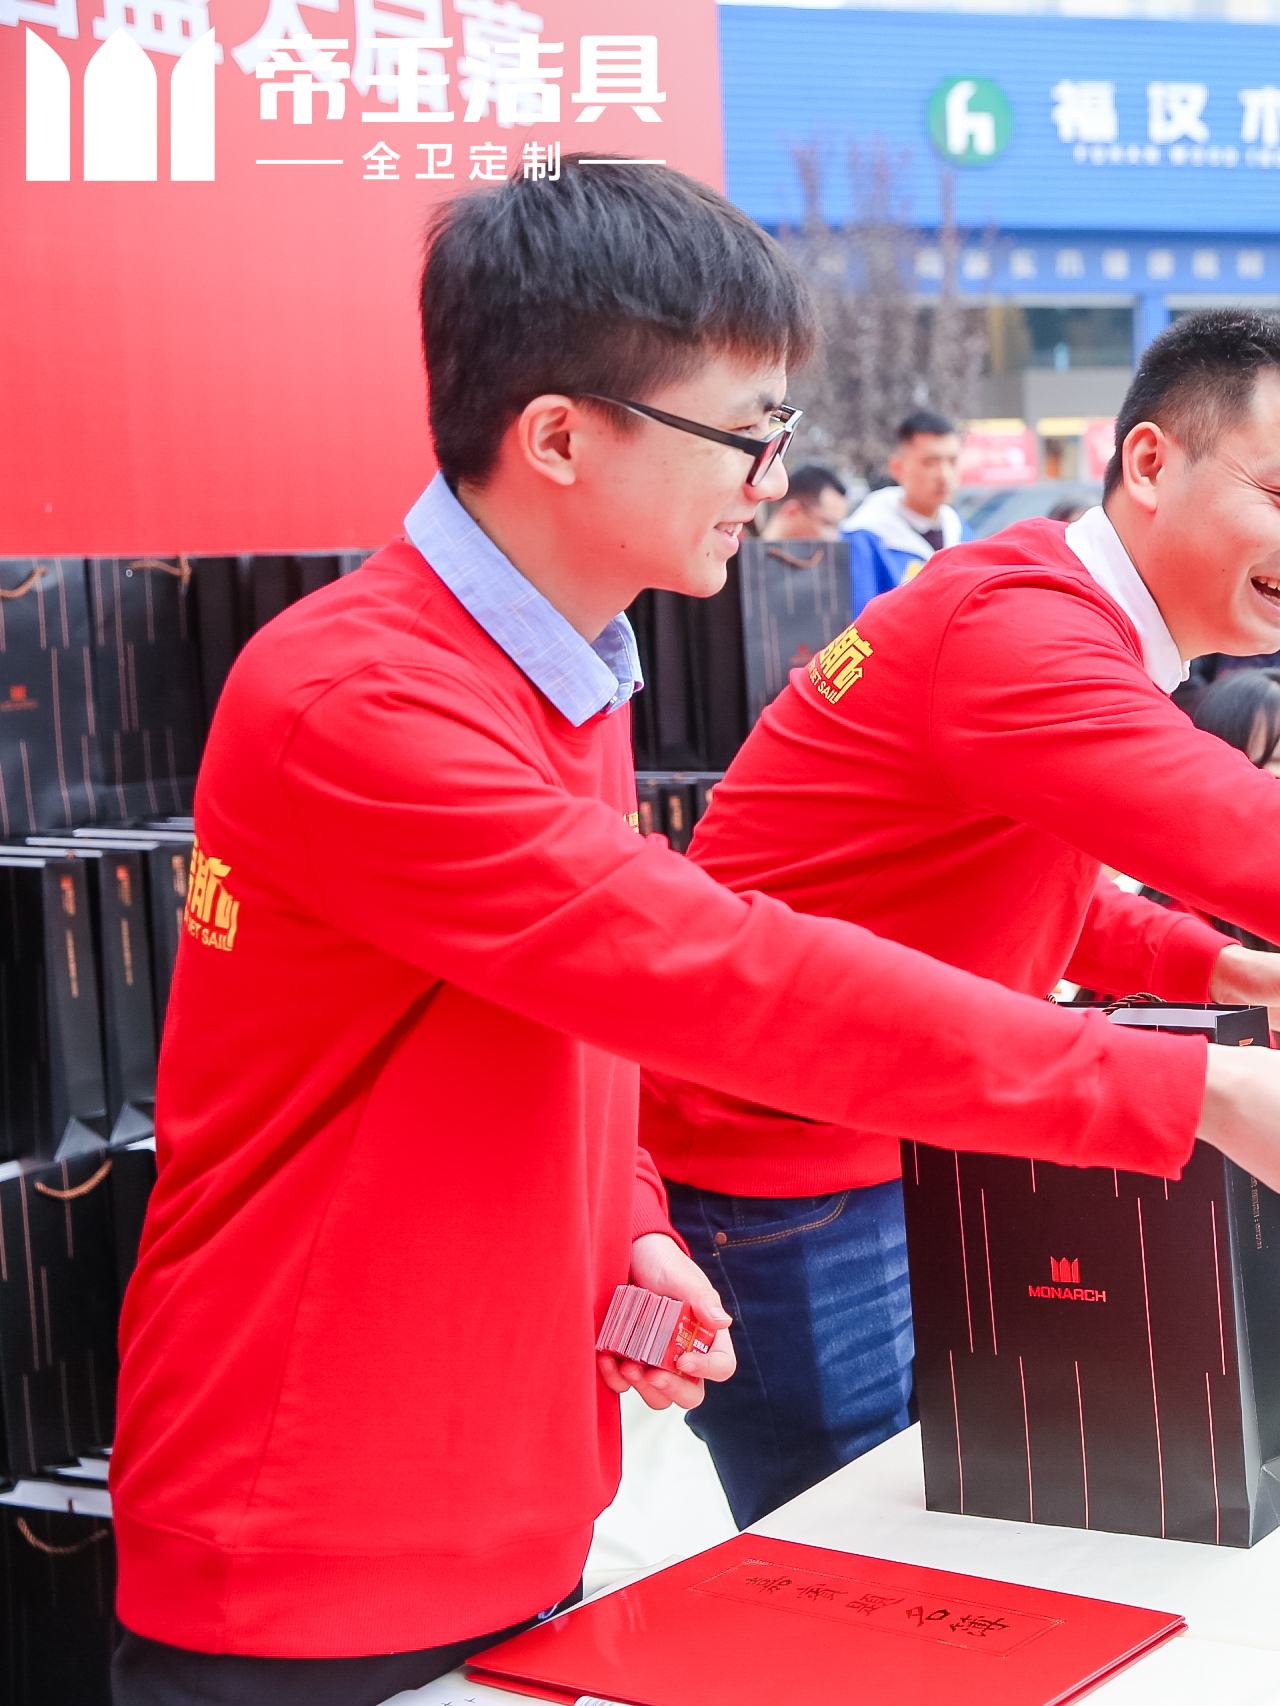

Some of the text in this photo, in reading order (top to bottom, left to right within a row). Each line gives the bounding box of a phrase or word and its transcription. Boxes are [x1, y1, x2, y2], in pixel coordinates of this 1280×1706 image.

[817, 681, 838, 704] SAIL
[201, 928, 233, 952] SAIL
[1028, 1285, 1107, 1303] MONARCH
